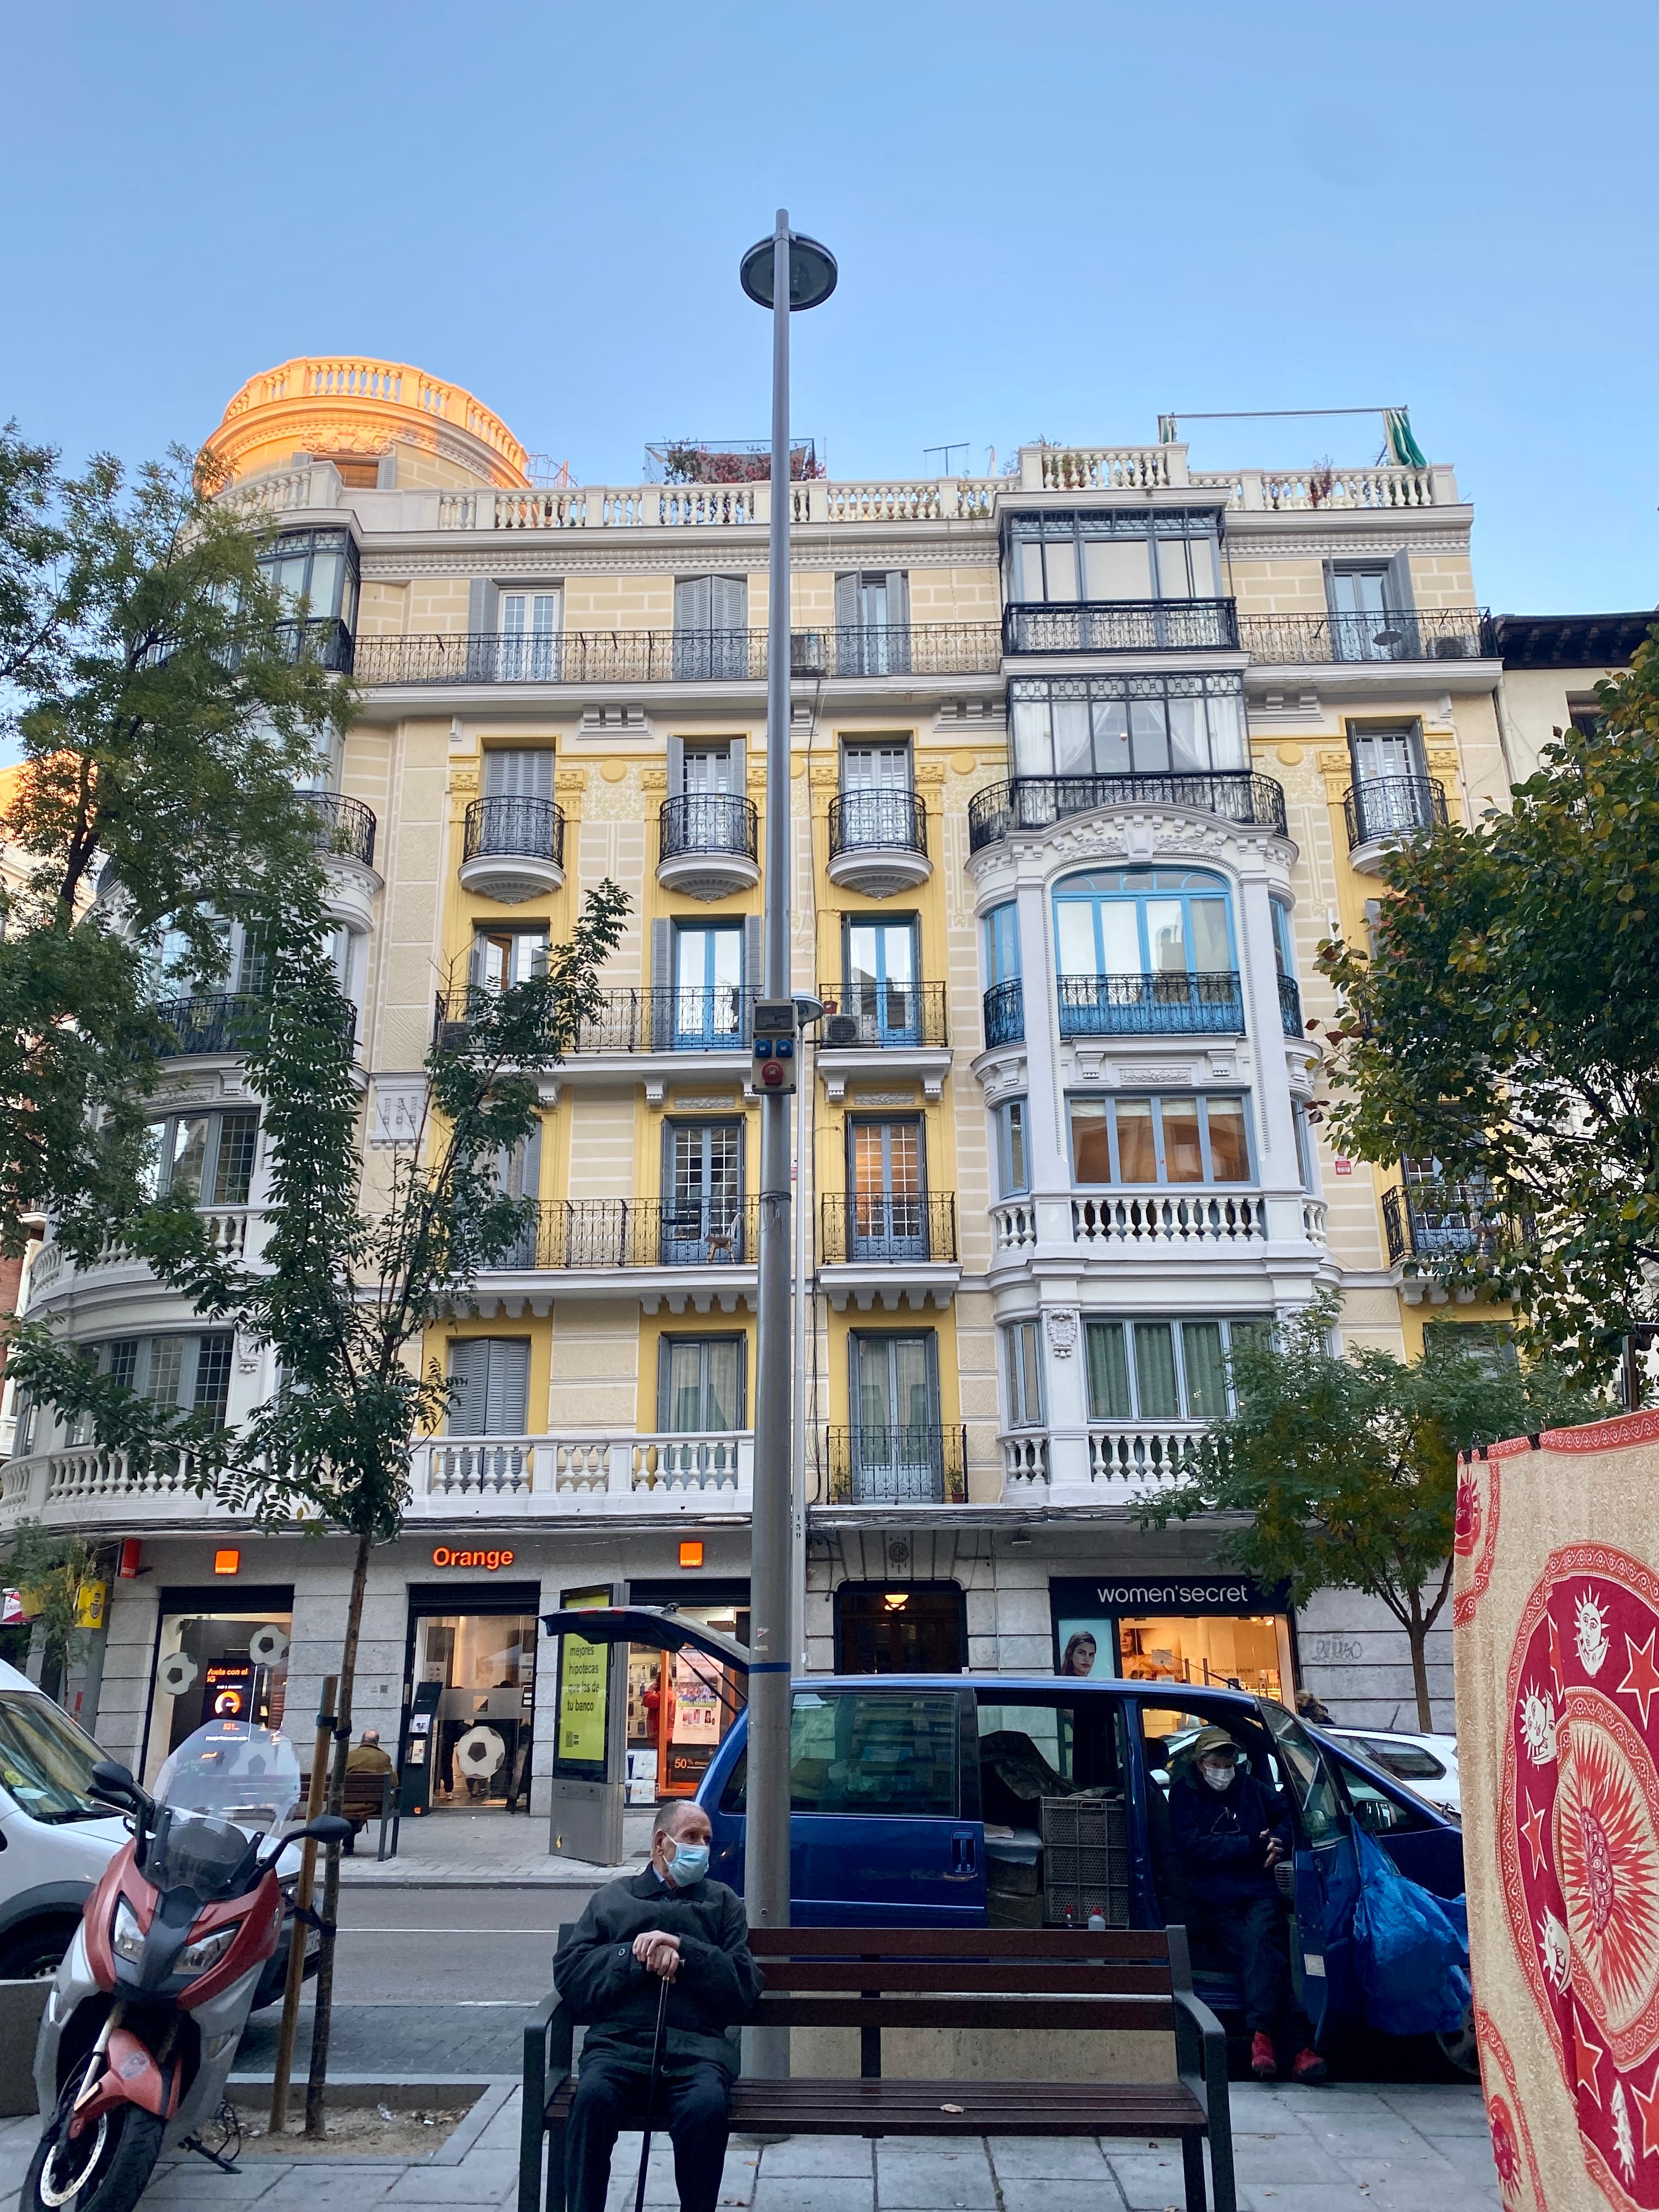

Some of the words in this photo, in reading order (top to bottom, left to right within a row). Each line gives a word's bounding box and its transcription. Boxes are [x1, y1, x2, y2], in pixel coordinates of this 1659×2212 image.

[433, 1547, 514, 1570] Orange
[1097, 1584, 1248, 1603] women'secret
[569, 1645, 594, 1658] mejores
[569, 1662, 599, 1677] hipotecas
[568, 1681, 580, 1695] que
[582, 1680, 590, 1693] las
[592, 1680, 600, 1693] de
[567, 1700, 574, 1711] tu
[575, 1699, 594, 1712] banco
